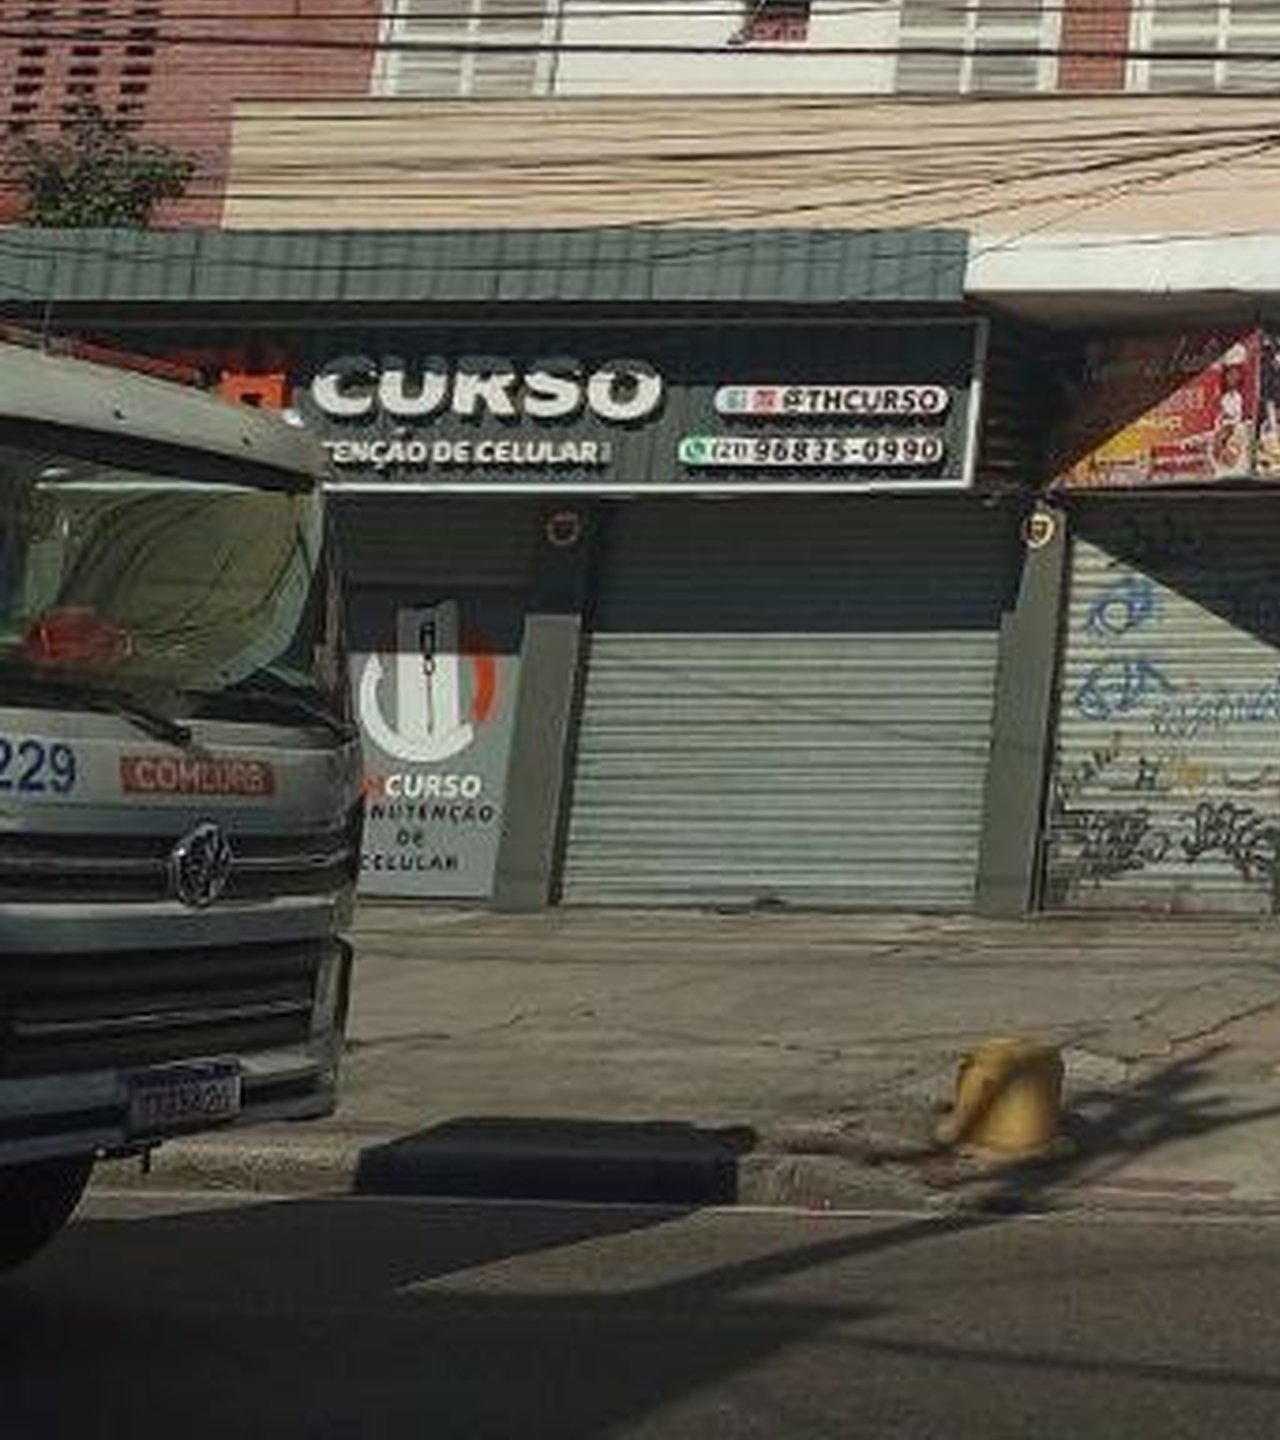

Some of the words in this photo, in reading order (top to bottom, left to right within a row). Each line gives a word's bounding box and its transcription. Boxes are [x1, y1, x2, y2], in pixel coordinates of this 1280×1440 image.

[312, 356, 662, 419] CURSO
[783, 389, 939, 411] @THCURSO
[433, 441, 471, 462] DE
[475, 440, 599, 464] CELULAR
[754, 440, 939, 462] 96835-0990
